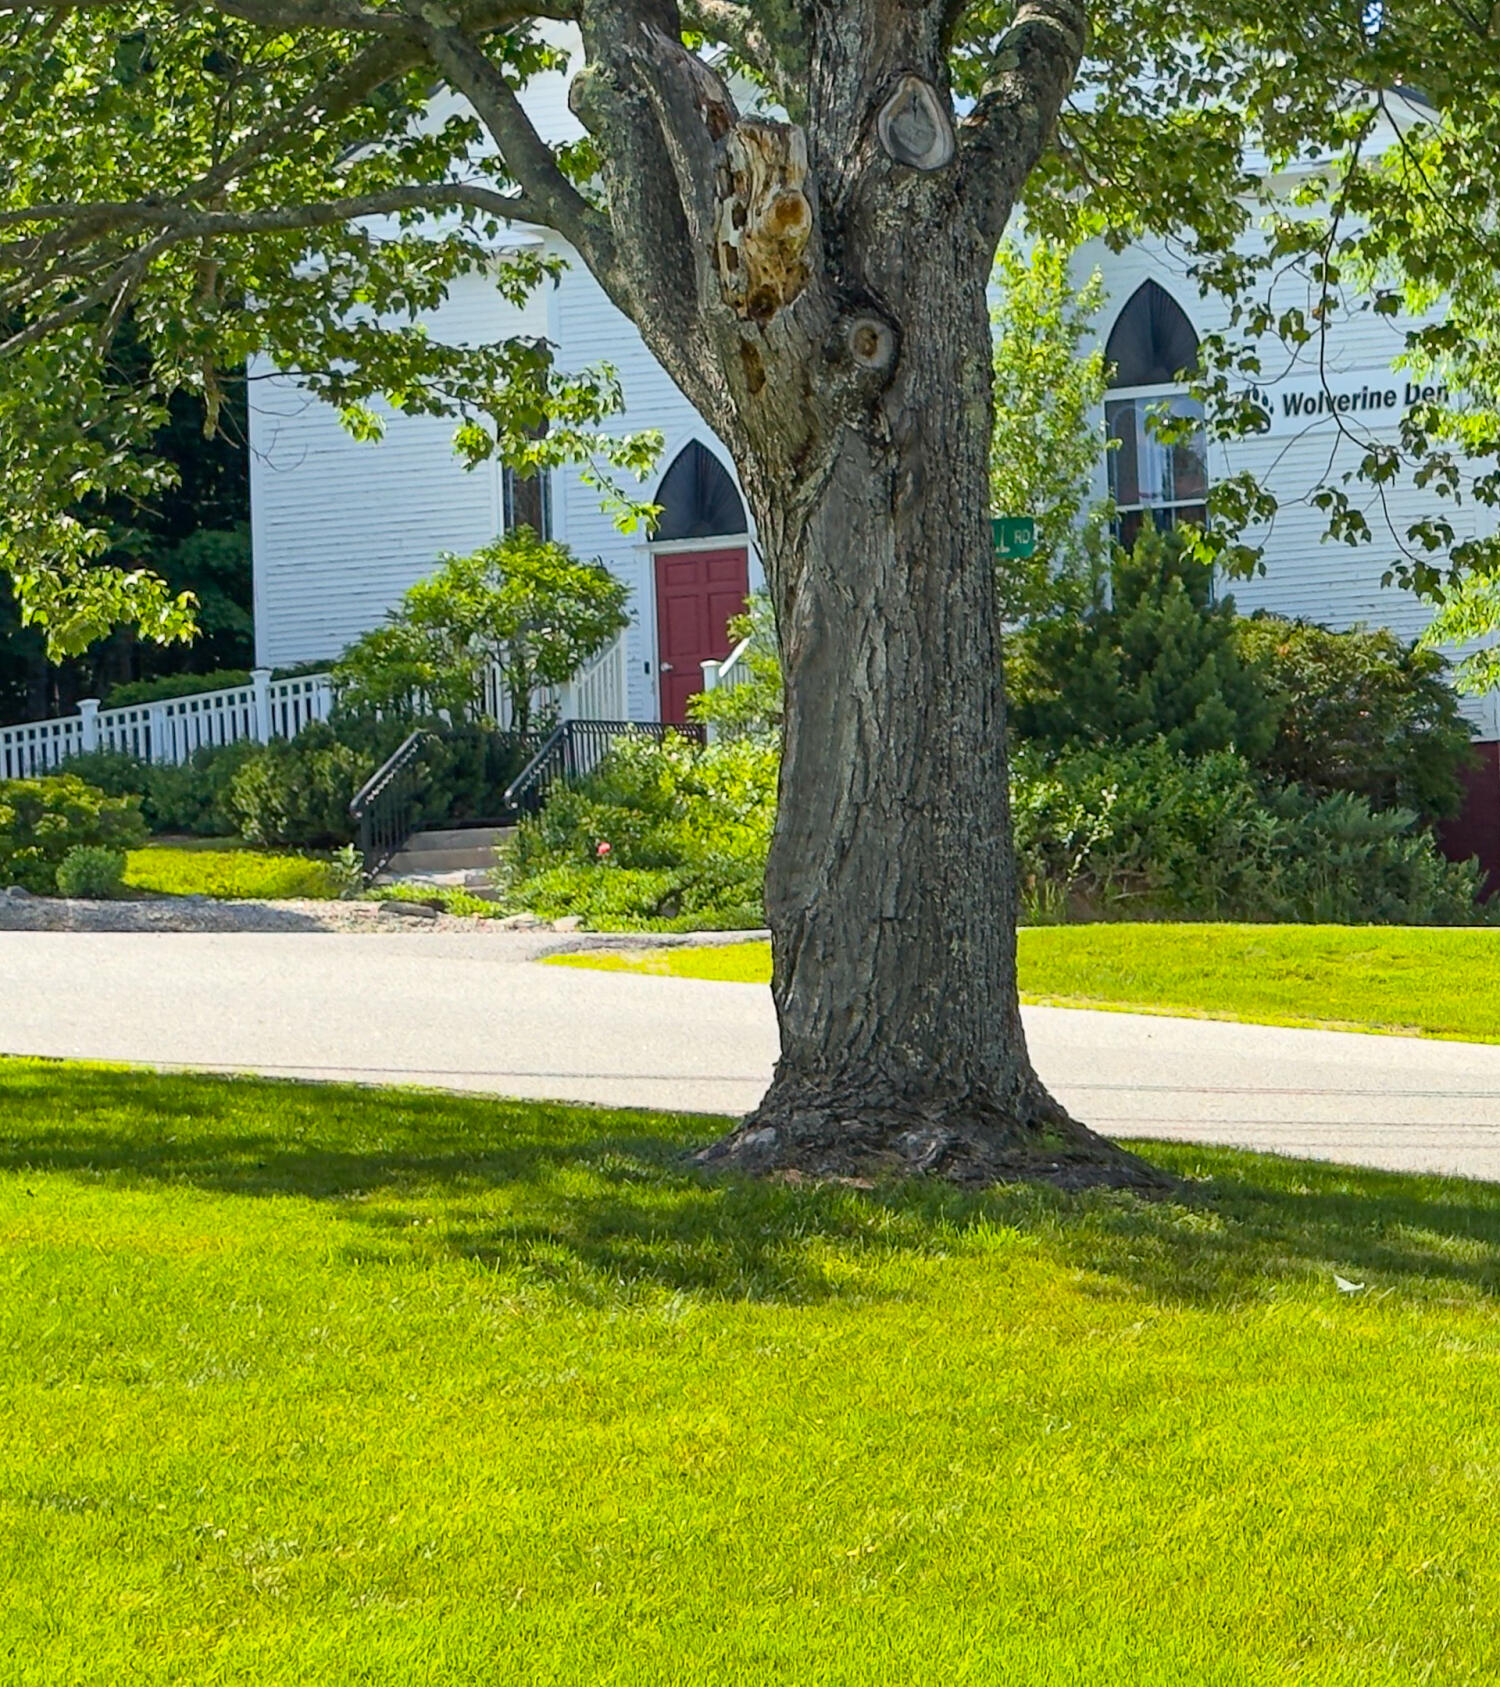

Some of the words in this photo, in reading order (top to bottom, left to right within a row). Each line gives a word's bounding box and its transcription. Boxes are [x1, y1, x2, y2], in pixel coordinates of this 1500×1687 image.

[1282, 385, 1397, 417] Wolverine
[1404, 382, 1449, 405] Den
[1013, 528, 1032, 545] RD
